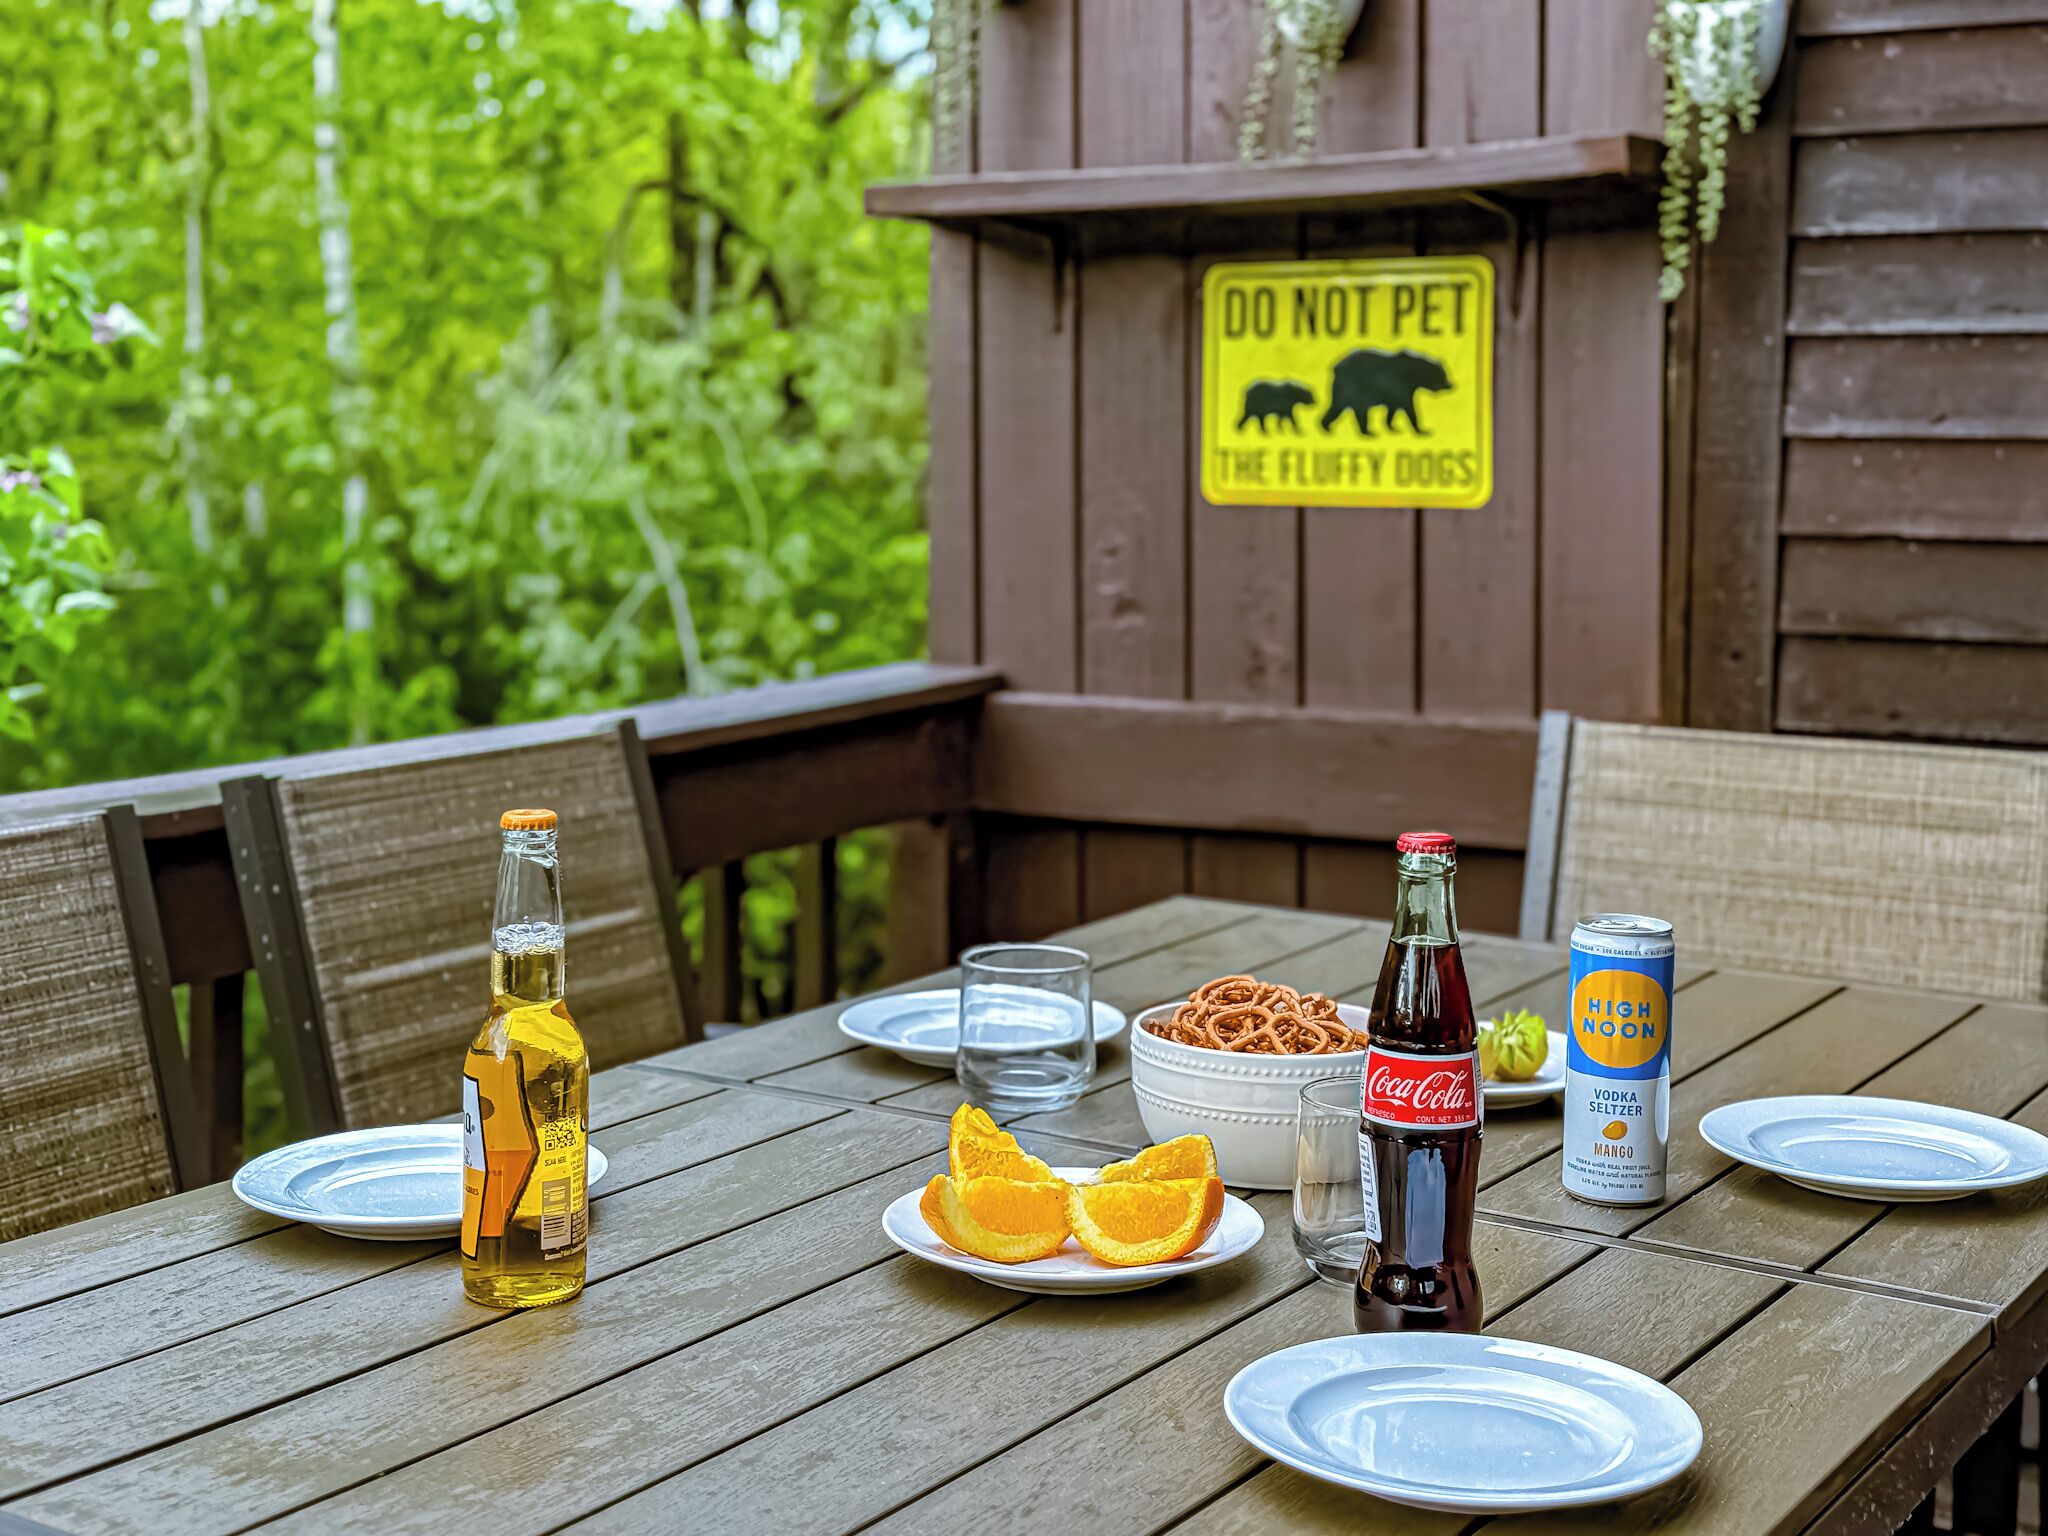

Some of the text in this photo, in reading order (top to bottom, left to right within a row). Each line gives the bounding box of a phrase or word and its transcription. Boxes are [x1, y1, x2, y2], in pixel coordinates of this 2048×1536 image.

[1225, 282, 1472, 339] DO NOT PET
[1217, 449, 1475, 488] THE FLUFFY DOGS
[1588, 998, 1651, 1018] HIGH
[1583, 1017, 1655, 1039] NOON
[1368, 1066, 1468, 1109] Coca-Cola
[1594, 1088, 1637, 1103] VODKA
[1589, 1101, 1643, 1116] SELTZER
[1594, 1142, 1634, 1159] MANGO
[1587, 1168, 1605, 1176] WATER
[1592, 1161, 1606, 1169] with
